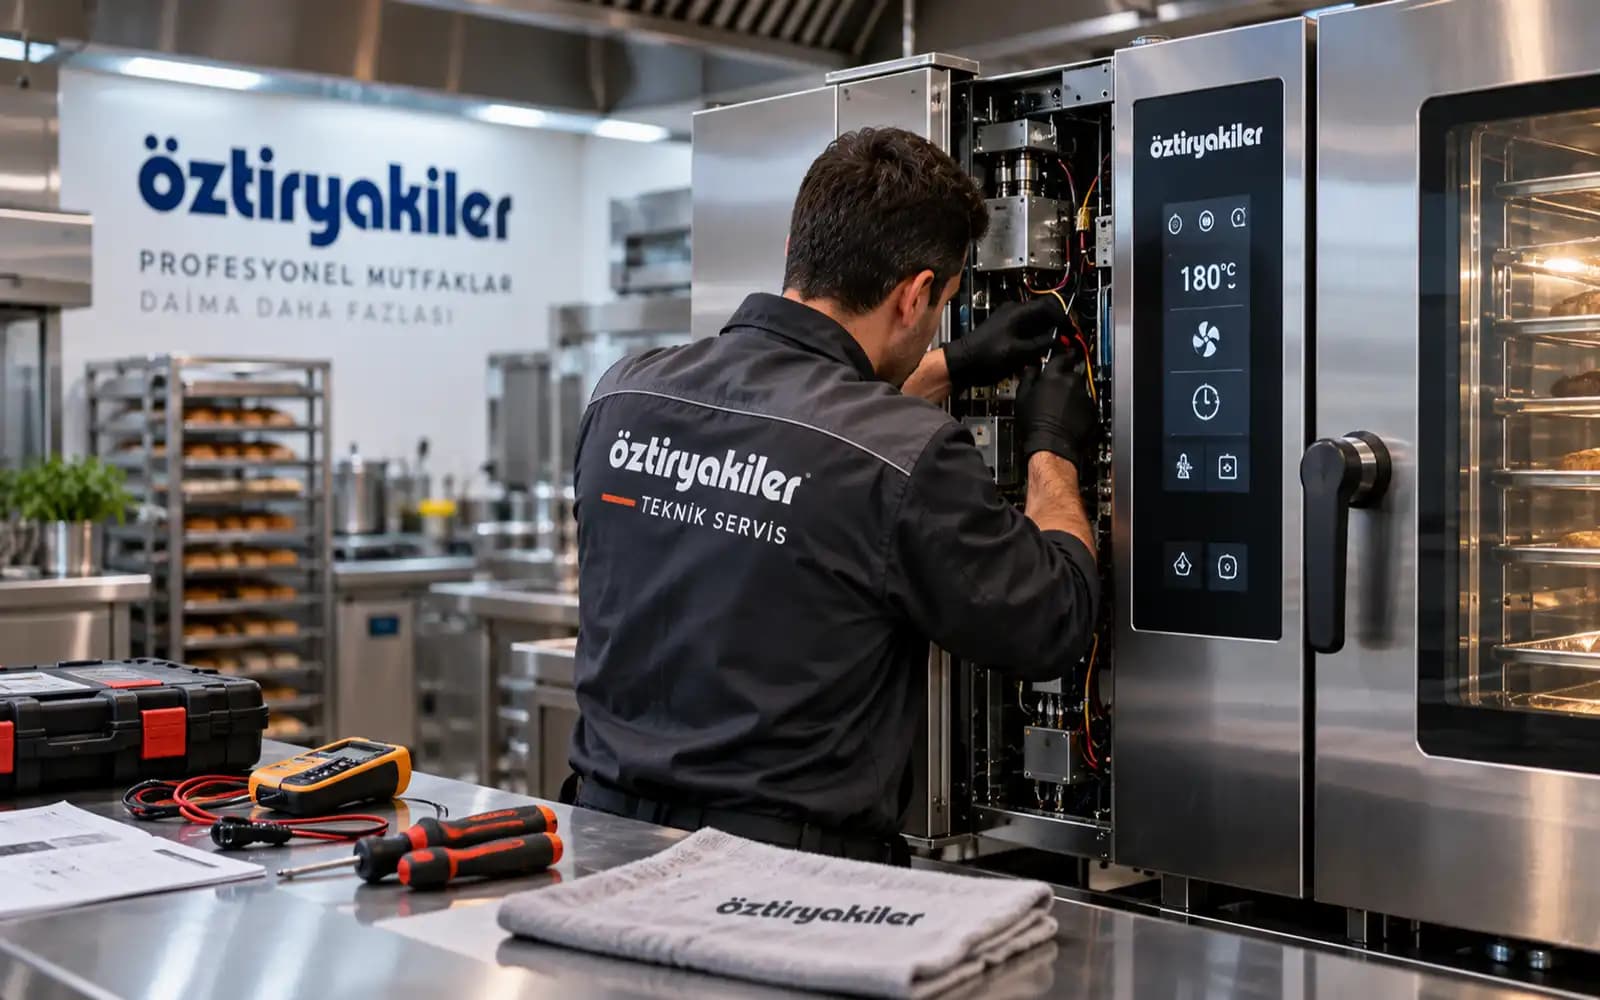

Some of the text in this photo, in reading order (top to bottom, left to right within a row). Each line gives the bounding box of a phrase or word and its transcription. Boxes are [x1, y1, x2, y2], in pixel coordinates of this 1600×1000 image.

[1150, 123, 1264, 159] öztiryakiler
[138, 133, 513, 248] öztiryakiler
[139, 249, 513, 295] PROFESYONEL MUTFAKLAR
[140, 289, 455, 327] DAİMA DAHA FAZLASI
[608, 429, 803, 505] öztiryakiler
[641, 495, 788, 545] TEKNİK SERVİS
[716, 896, 926, 927] öztiryakiler
